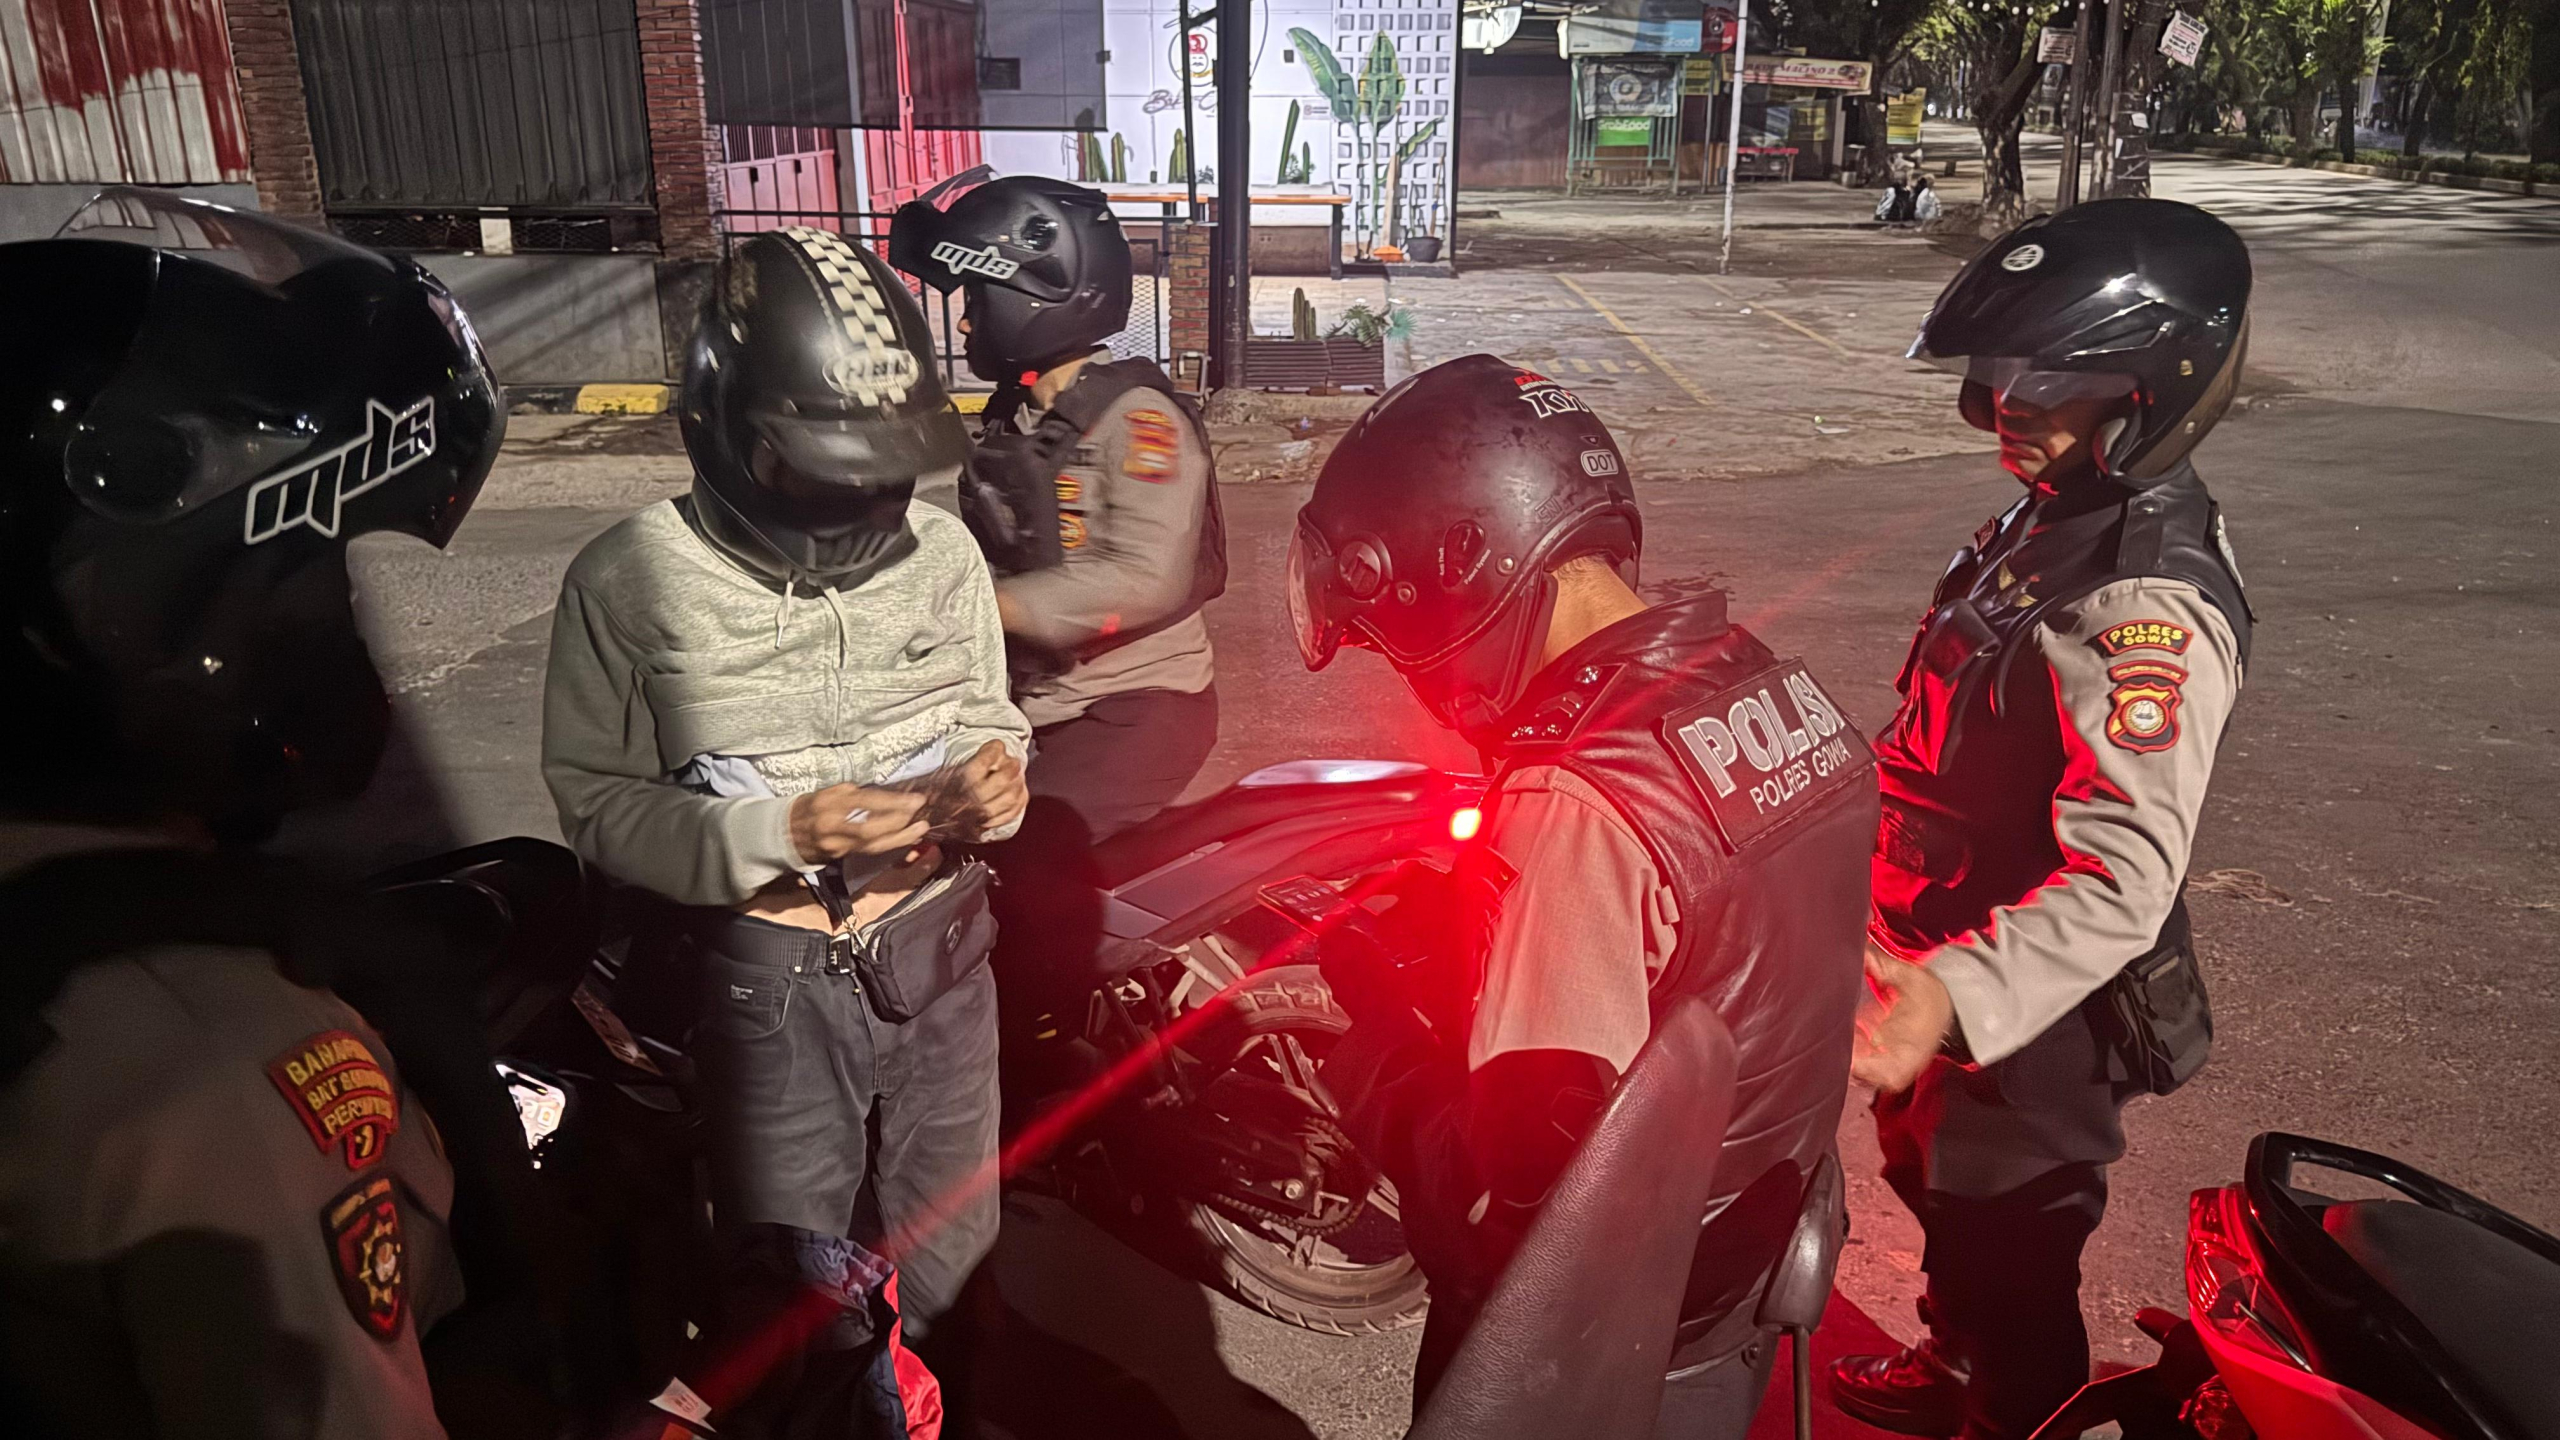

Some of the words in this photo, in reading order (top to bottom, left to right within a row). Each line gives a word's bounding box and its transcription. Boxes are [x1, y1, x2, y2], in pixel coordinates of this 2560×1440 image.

[245, 395, 437, 545] mds
[1586, 453, 1616, 472] DOT
[2109, 623, 2183, 643] POLRES
[2122, 634, 2172, 646] GOWA
[1677, 670, 1846, 799] POLISI
[1749, 758, 1812, 815] POLRES
[1811, 735, 1852, 778] GOWA
